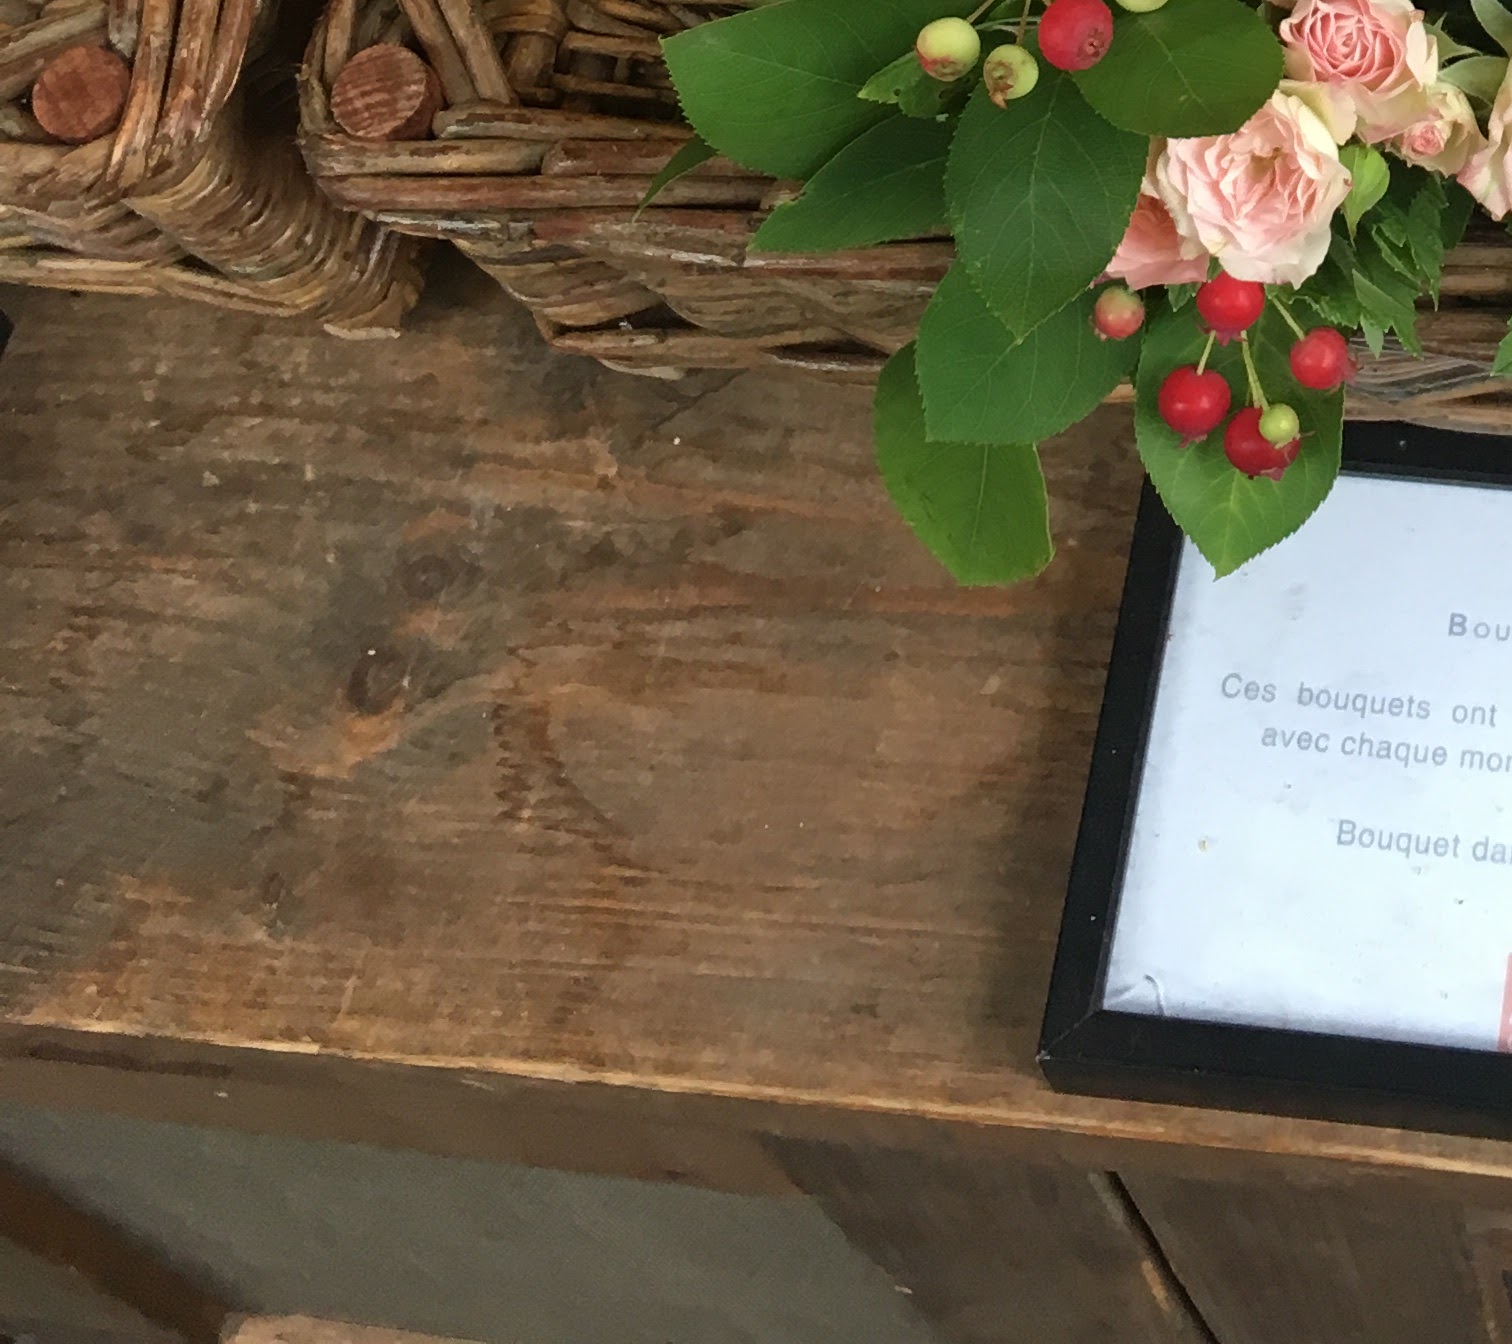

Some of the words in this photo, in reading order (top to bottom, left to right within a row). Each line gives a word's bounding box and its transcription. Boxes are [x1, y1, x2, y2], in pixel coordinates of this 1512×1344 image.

[1220, 672, 1277, 703] Ces
[1297, 681, 1432, 720] bouquets
[1451, 704, 1497, 728] ont
[1261, 726, 1330, 753] avec
[1340, 732, 1448, 769] chaque
[1336, 819, 1461, 859] Bouquet
